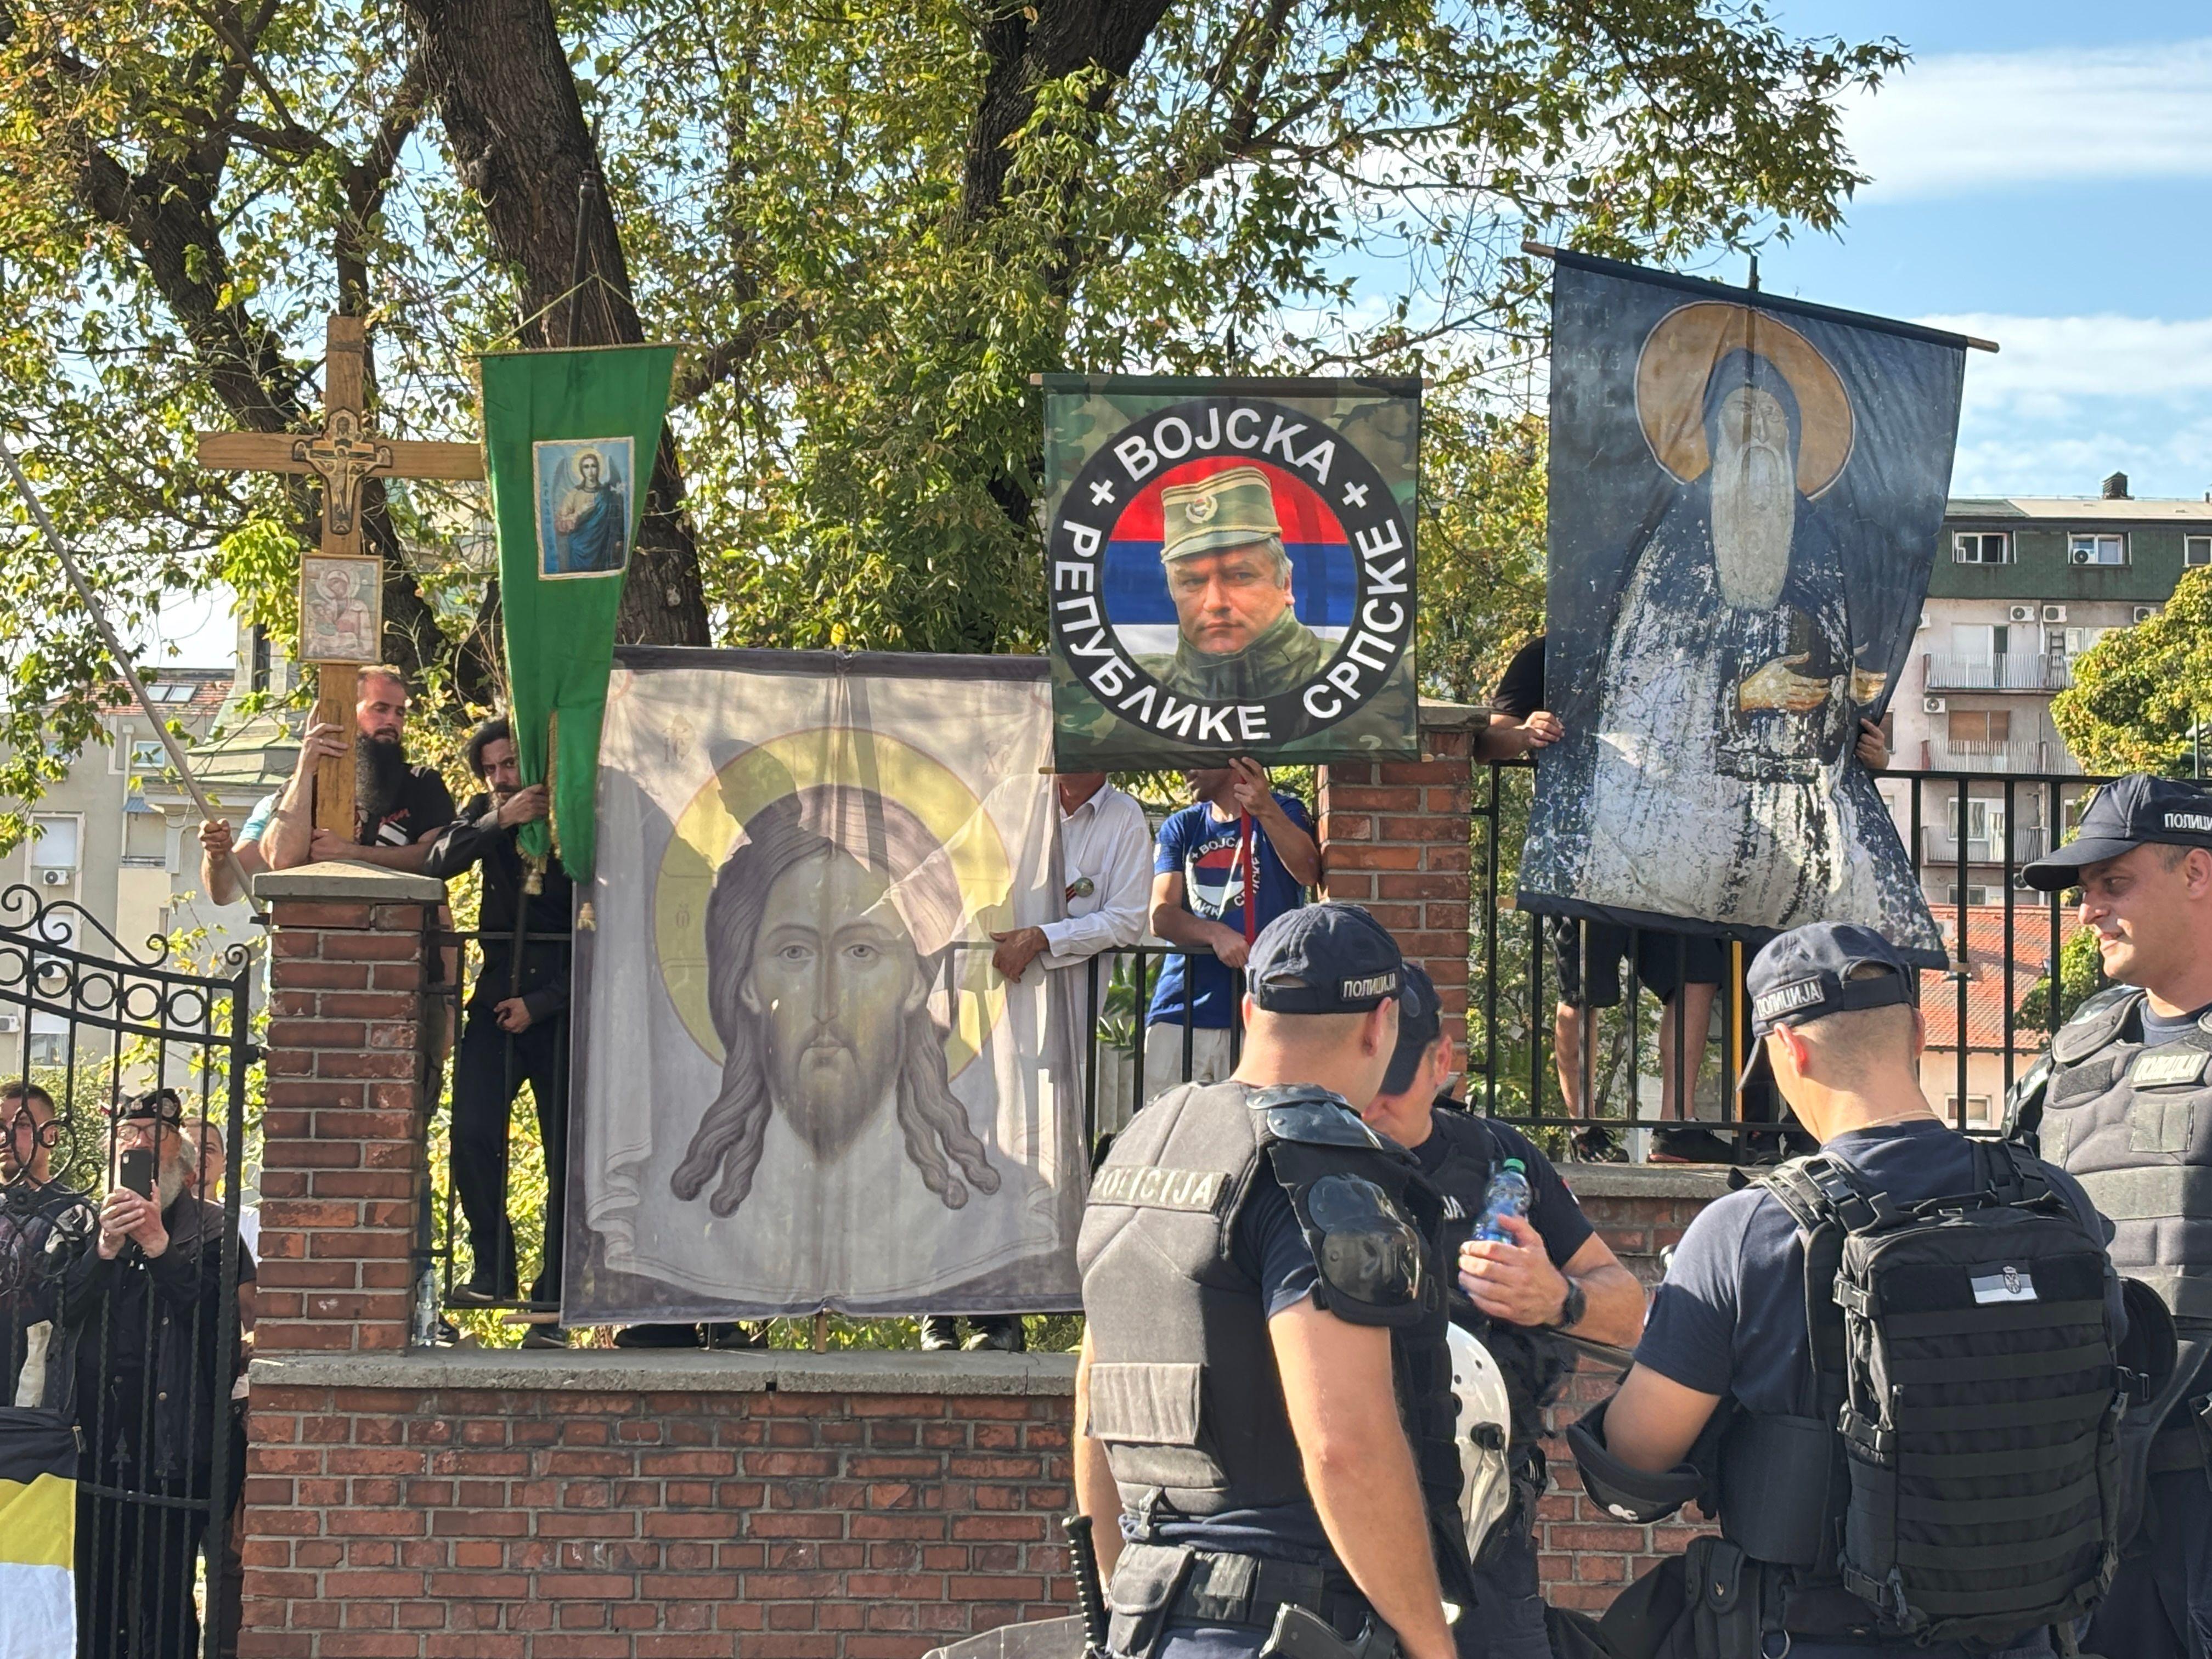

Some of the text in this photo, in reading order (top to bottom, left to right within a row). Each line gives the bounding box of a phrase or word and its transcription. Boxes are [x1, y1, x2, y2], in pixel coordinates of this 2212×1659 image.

[1114, 408, 1336, 486] ВОЈСКА
[1055, 518, 1408, 742] РЕПУБЛИКЕ СРПСКЕ
[1343, 973, 1396, 998] ПОЛИЦИЈА
[1756, 981, 1820, 1018] ПОЛИЦИЈА
